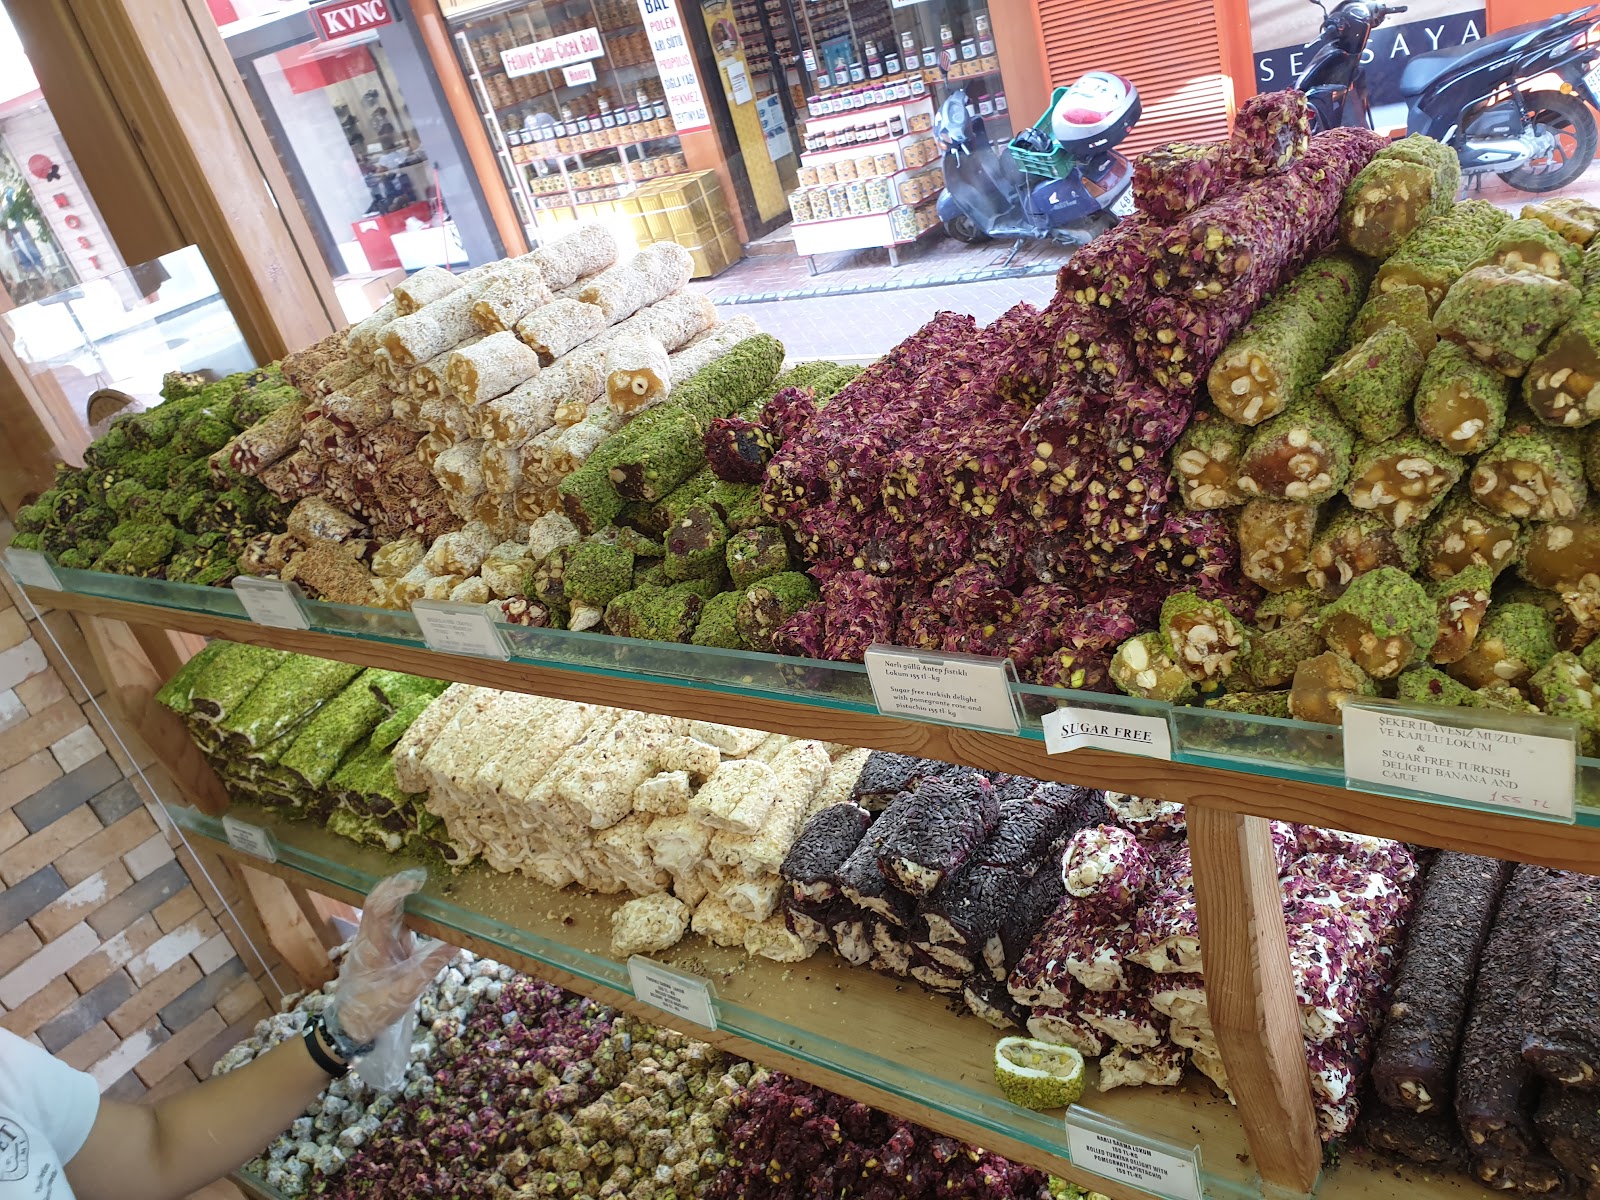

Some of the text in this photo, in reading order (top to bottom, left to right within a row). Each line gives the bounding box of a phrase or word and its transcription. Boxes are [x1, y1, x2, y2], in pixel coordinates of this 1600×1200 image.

[643, 0, 670, 14] BAL
[321, 0, 387, 34] KVNC
[649, 16, 677, 33] POLEN
[1259, 19, 1482, 82] SESAYA
[885, 669, 909, 678] Lokum
[902, 662, 921, 671] güllü
[921, 665, 943, 675] Antep
[890, 685, 977, 704] Sugar free turkish delight
[895, 702, 927, 712] pistachio
[1061, 722, 1153, 742] SUGAR FREE
[1379, 716, 1416, 730] ŞEKER
[1477, 731, 1523, 746] MUZLU
[1379, 727, 1493, 753] VE KAJULU LOKUM
[1416, 744, 1426, 753] &
[1382, 749, 1511, 778] SUGAR FREE TURKISH
[1435, 768, 1487, 785] BANANA
[1490, 778, 1519, 790] AND
